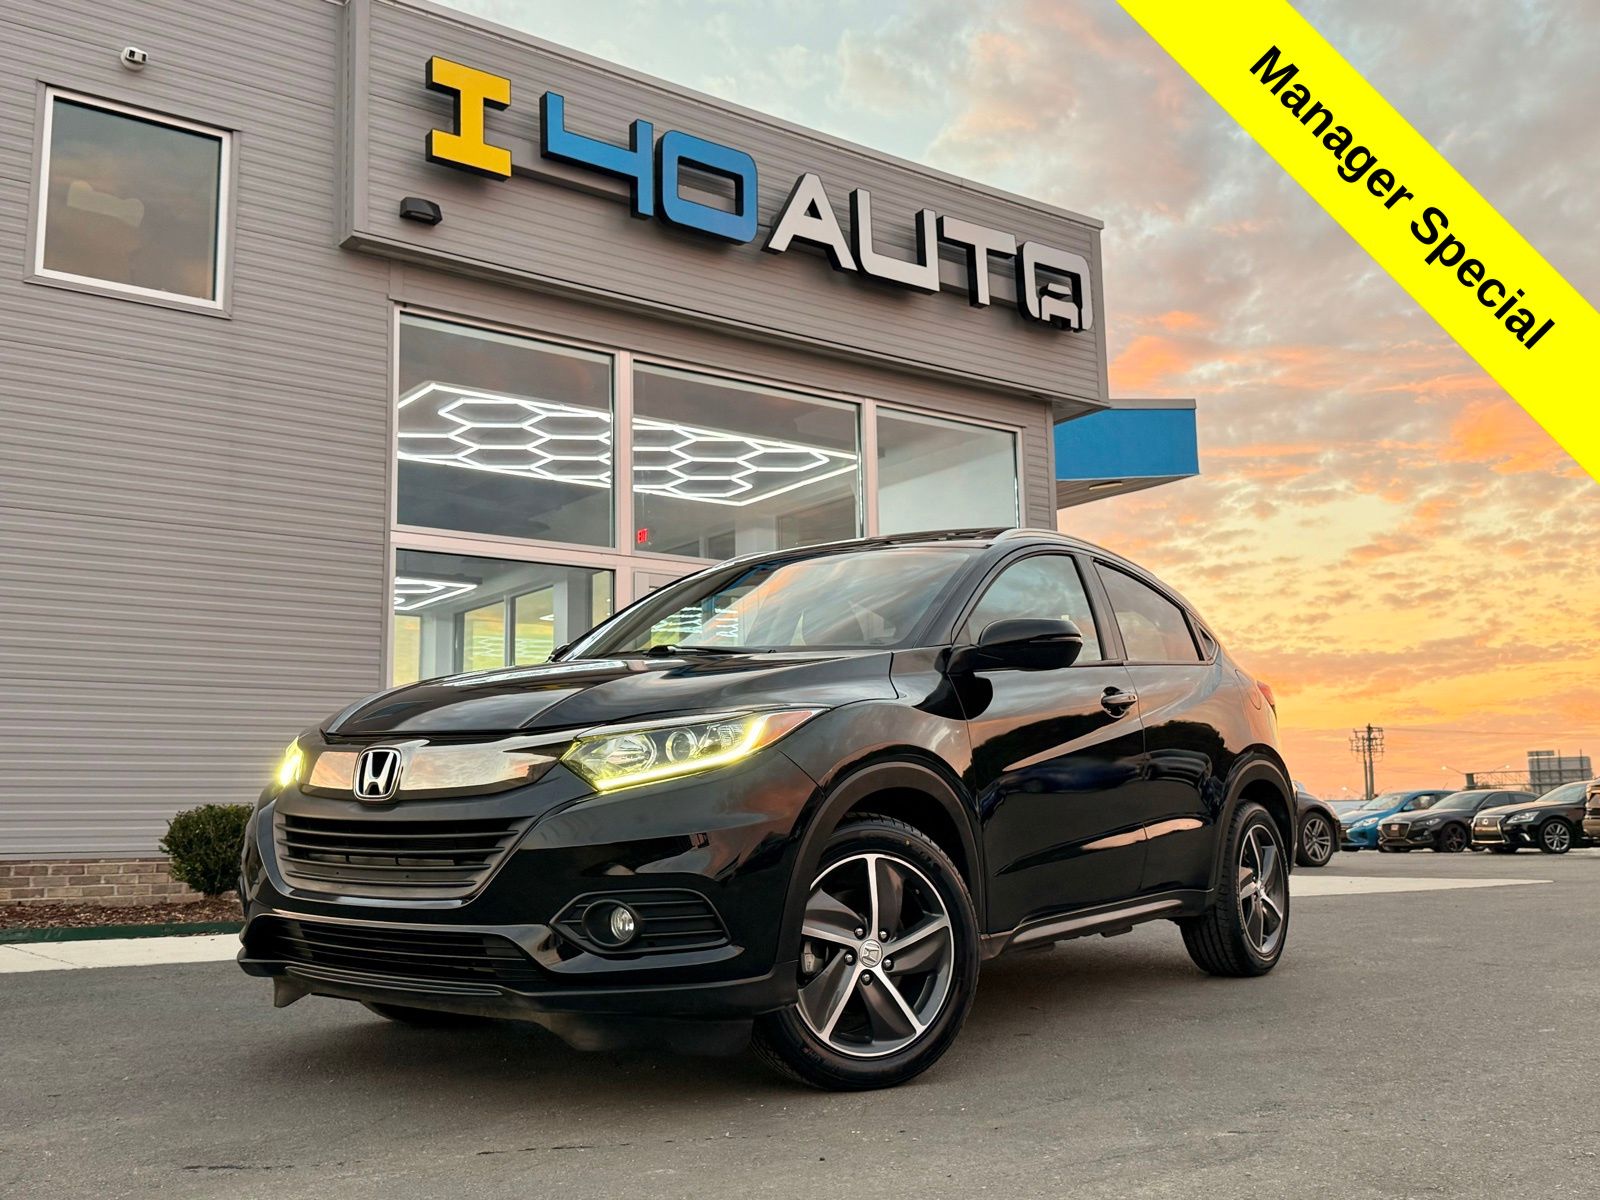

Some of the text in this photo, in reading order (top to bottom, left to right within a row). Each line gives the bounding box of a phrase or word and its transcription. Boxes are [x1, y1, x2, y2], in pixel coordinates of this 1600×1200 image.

[426, 55, 1093, 332] I 40 AUTO
